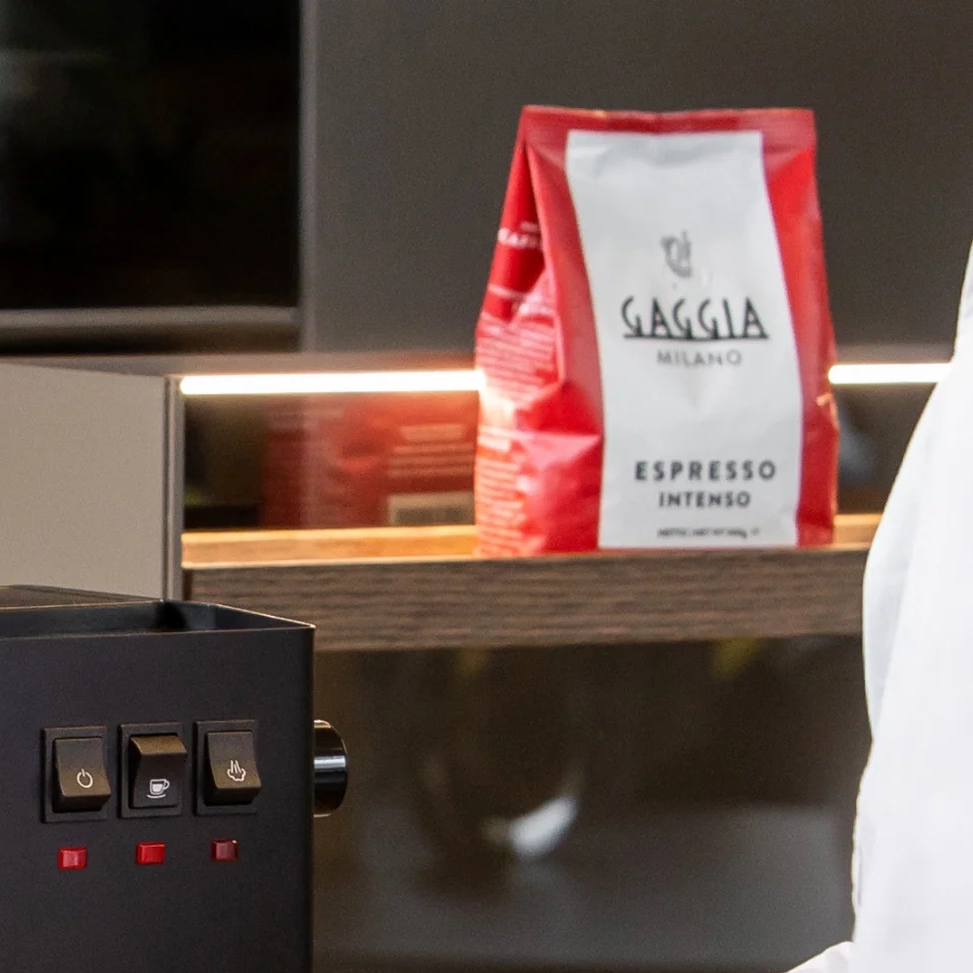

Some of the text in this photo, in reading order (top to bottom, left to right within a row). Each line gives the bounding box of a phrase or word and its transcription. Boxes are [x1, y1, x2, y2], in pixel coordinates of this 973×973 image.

[621, 296, 769, 341] GAGGIA
[656, 349, 743, 367] MILANO
[634, 460, 777, 481] ESPRESSO
[659, 491, 751, 508] INTENSO
